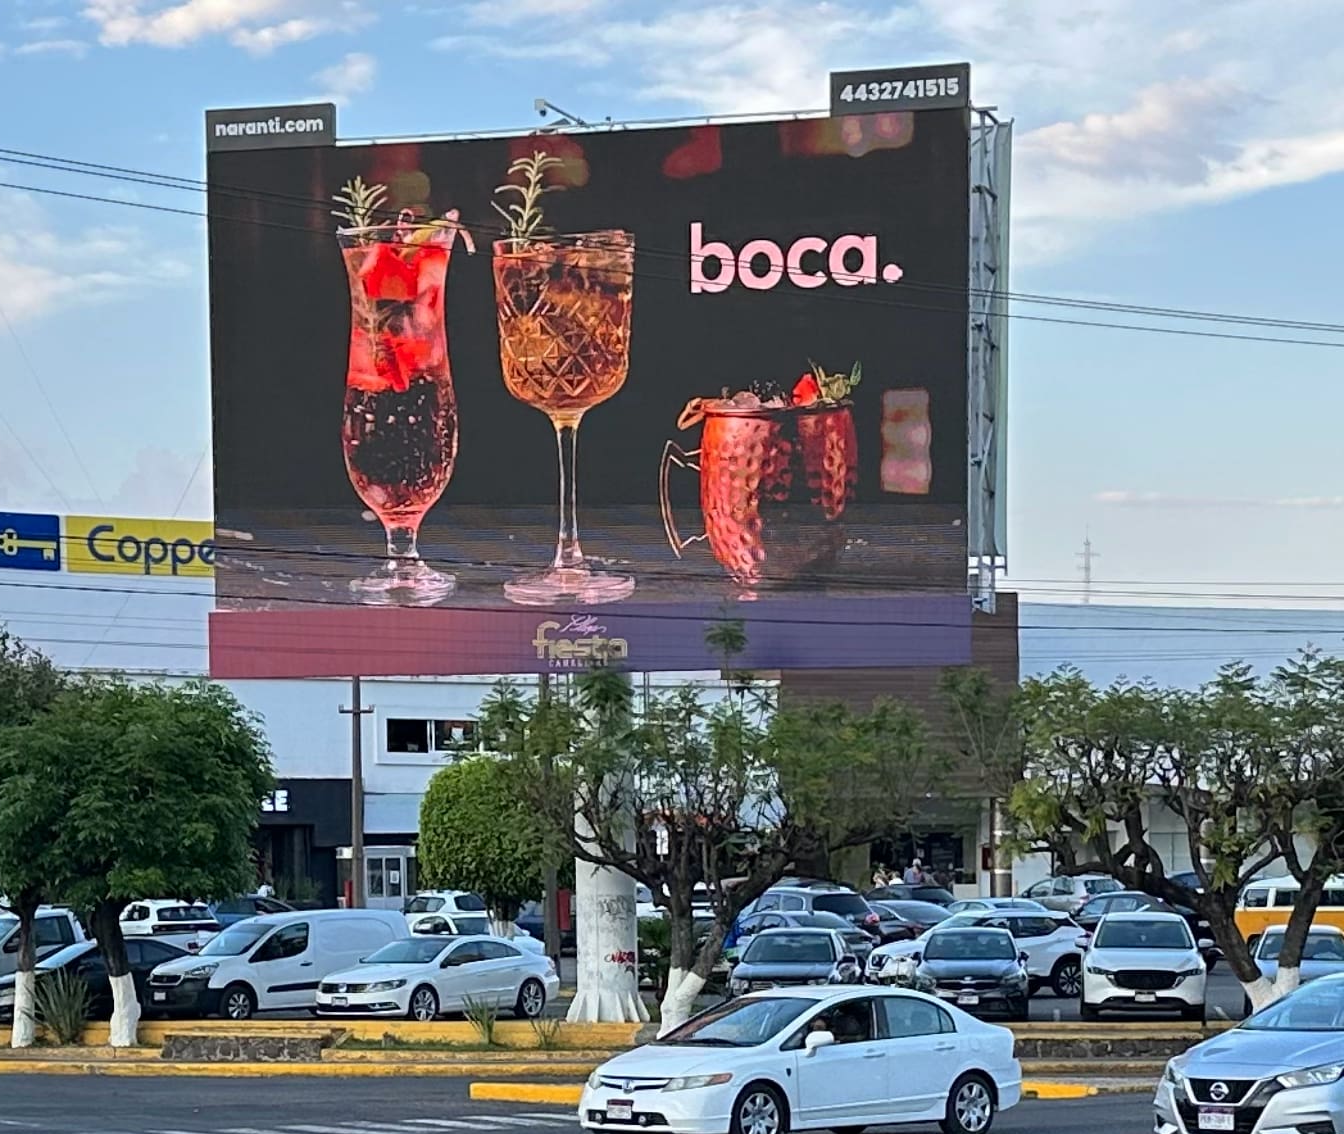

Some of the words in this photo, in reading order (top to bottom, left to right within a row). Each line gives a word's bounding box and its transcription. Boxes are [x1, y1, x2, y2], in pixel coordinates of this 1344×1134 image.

[840, 77, 959, 102] 4432741515
[215, 116, 324, 137] naranti.com
[690, 222, 904, 294] boca.
[87, 524, 215, 576] Coppe
